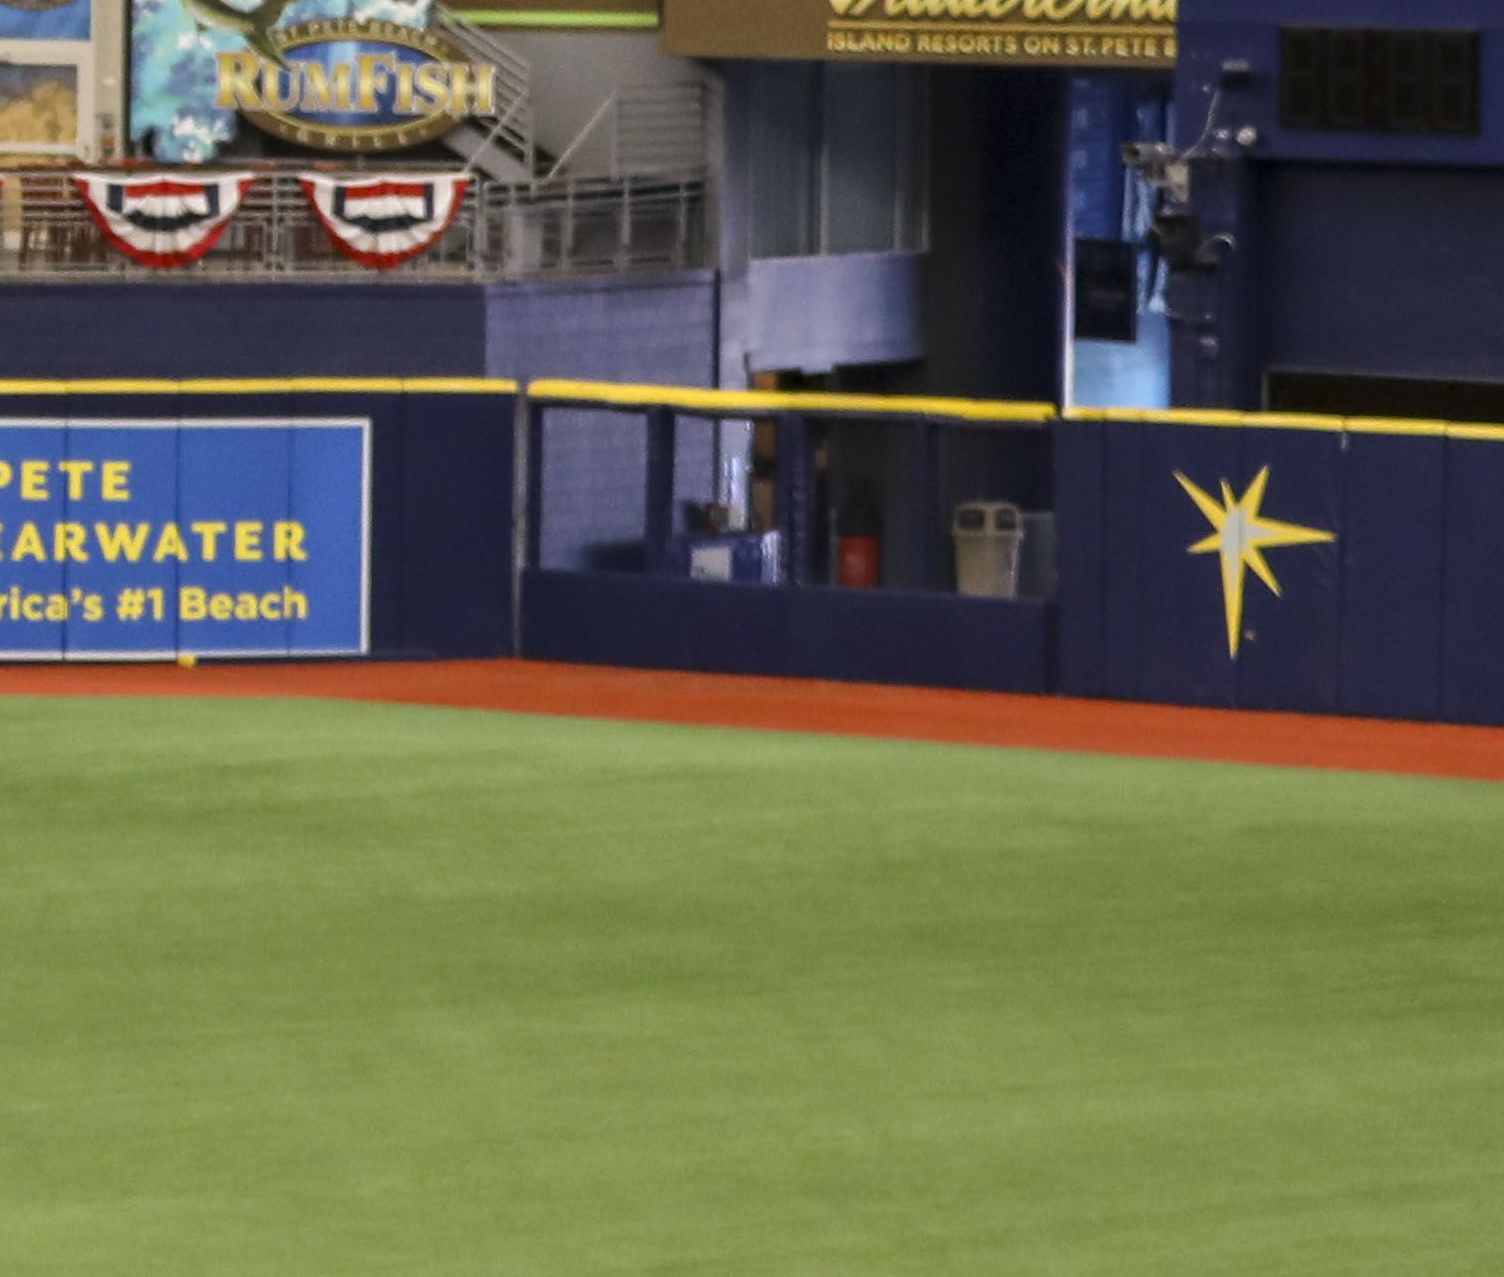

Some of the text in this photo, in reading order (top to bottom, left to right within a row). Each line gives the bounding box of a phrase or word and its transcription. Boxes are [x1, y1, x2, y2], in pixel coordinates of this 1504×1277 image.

[826, 32, 910, 52] ISLAND
[917, 34, 1017, 54] RESORTS
[1023, 36, 1060, 55] ON
[116, 586, 164, 622] #1
[178, 586, 309, 622] Beach
